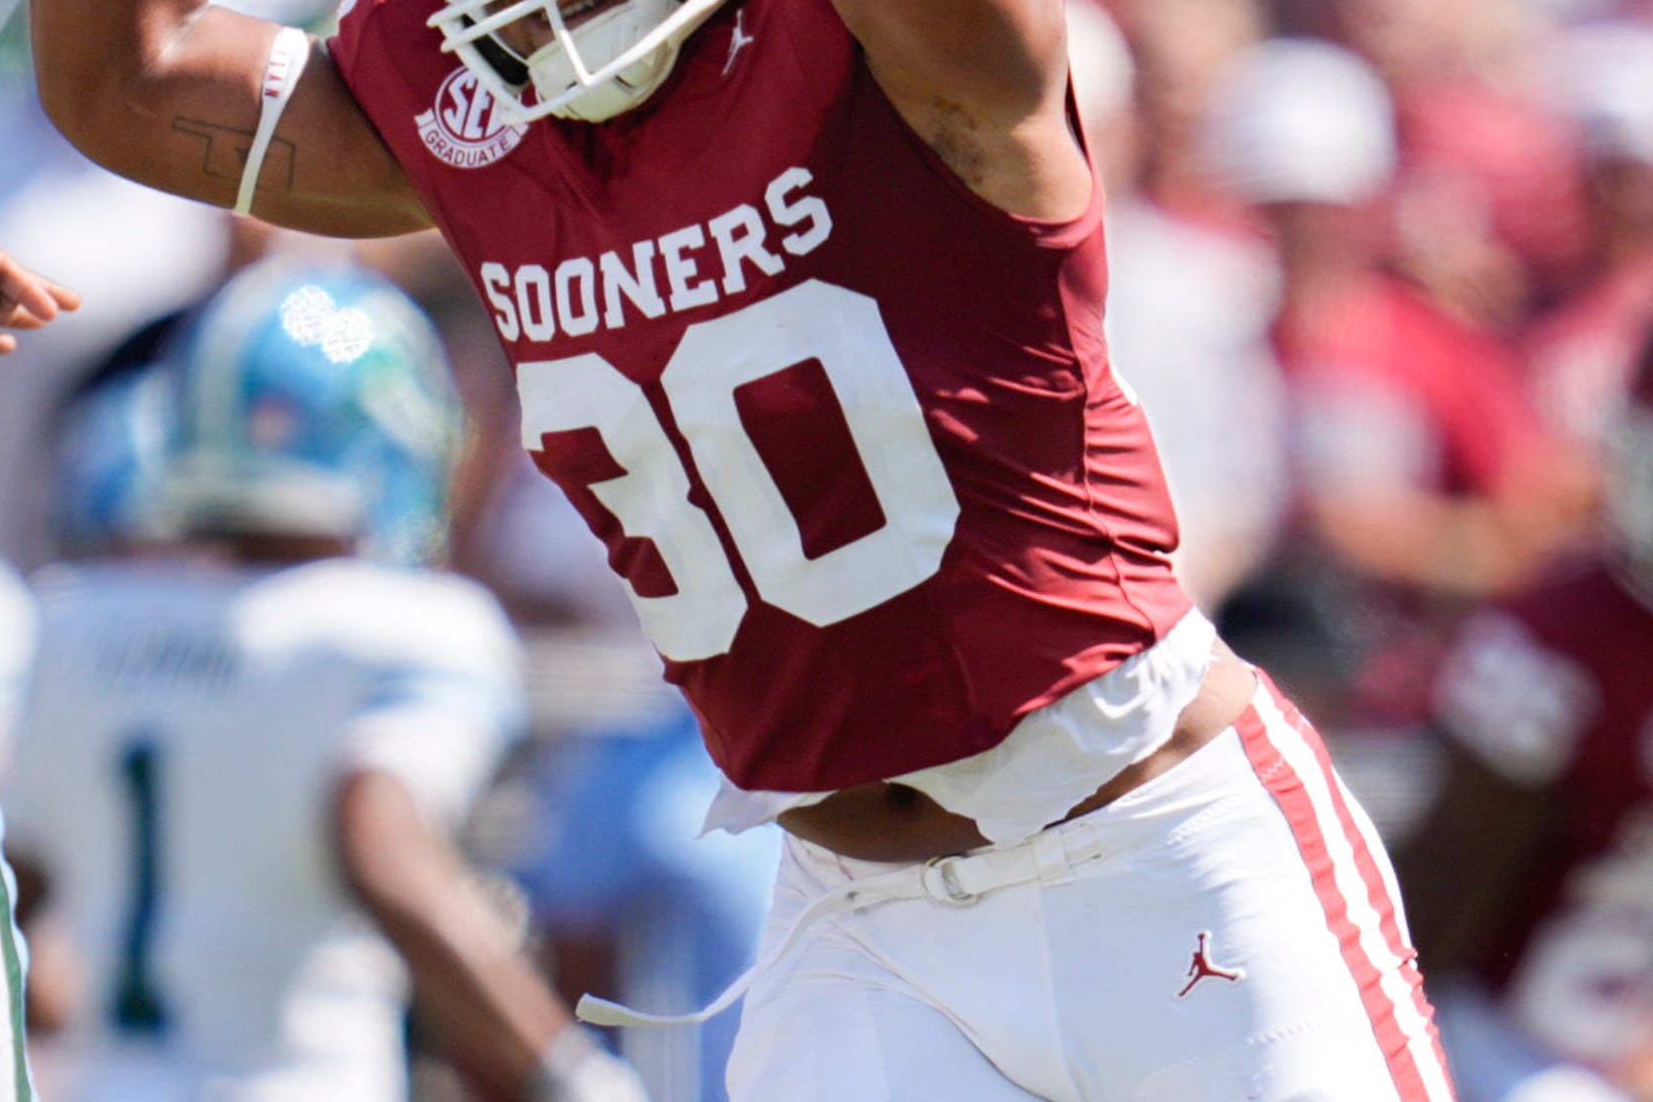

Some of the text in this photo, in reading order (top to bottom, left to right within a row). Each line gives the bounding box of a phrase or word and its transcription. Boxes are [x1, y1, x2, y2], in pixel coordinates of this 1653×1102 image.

[425, 129, 511, 166] GRADUATE
[480, 166, 833, 343] SOONERS
[515, 278, 962, 663] 30
